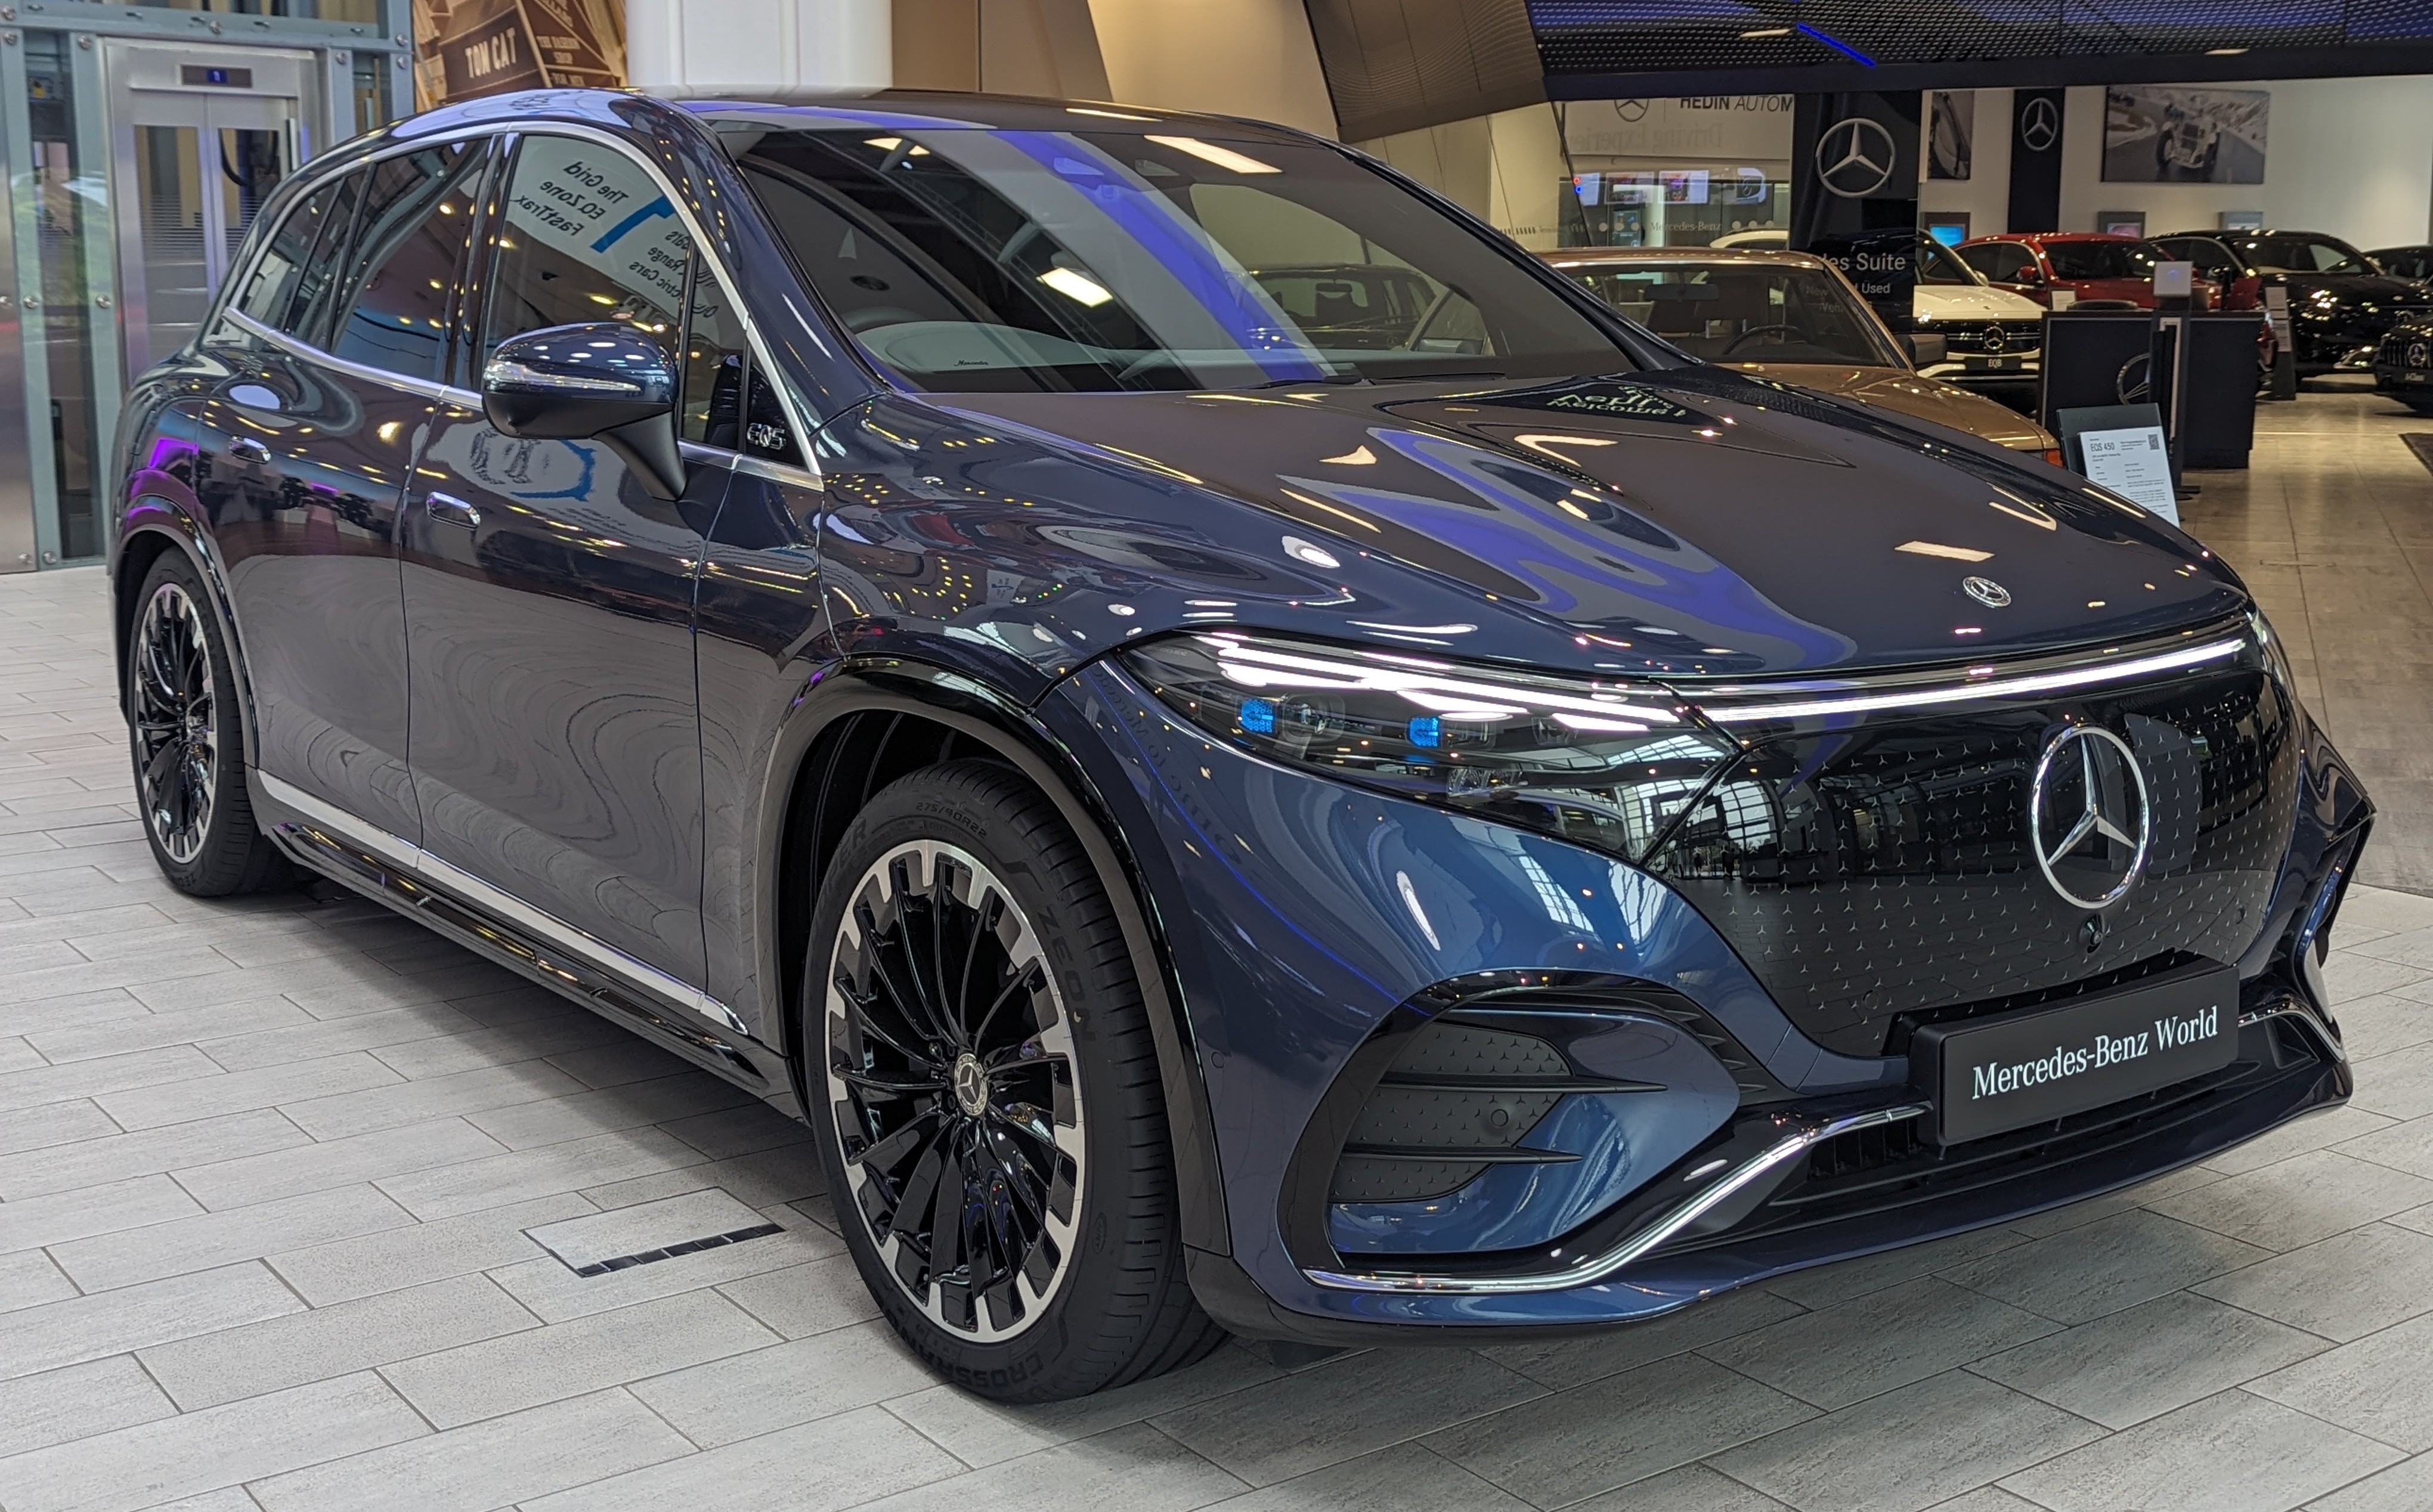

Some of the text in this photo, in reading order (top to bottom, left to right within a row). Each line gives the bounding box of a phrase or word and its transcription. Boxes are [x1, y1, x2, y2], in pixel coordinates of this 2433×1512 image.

[465, 27, 516, 79] TOM CAT
[1679, 96, 1729, 110] HEDIN
[1651, 222, 1721, 232] Mercedes-Benz
[1856, 252, 1906, 271] Suite
[1861, 283, 1891, 294] Used
[1988, 359, 2002, 368] EQB
[2104, 442, 2115, 451] 450
[1971, 1005, 2218, 1100] Mercedes-Benz World
